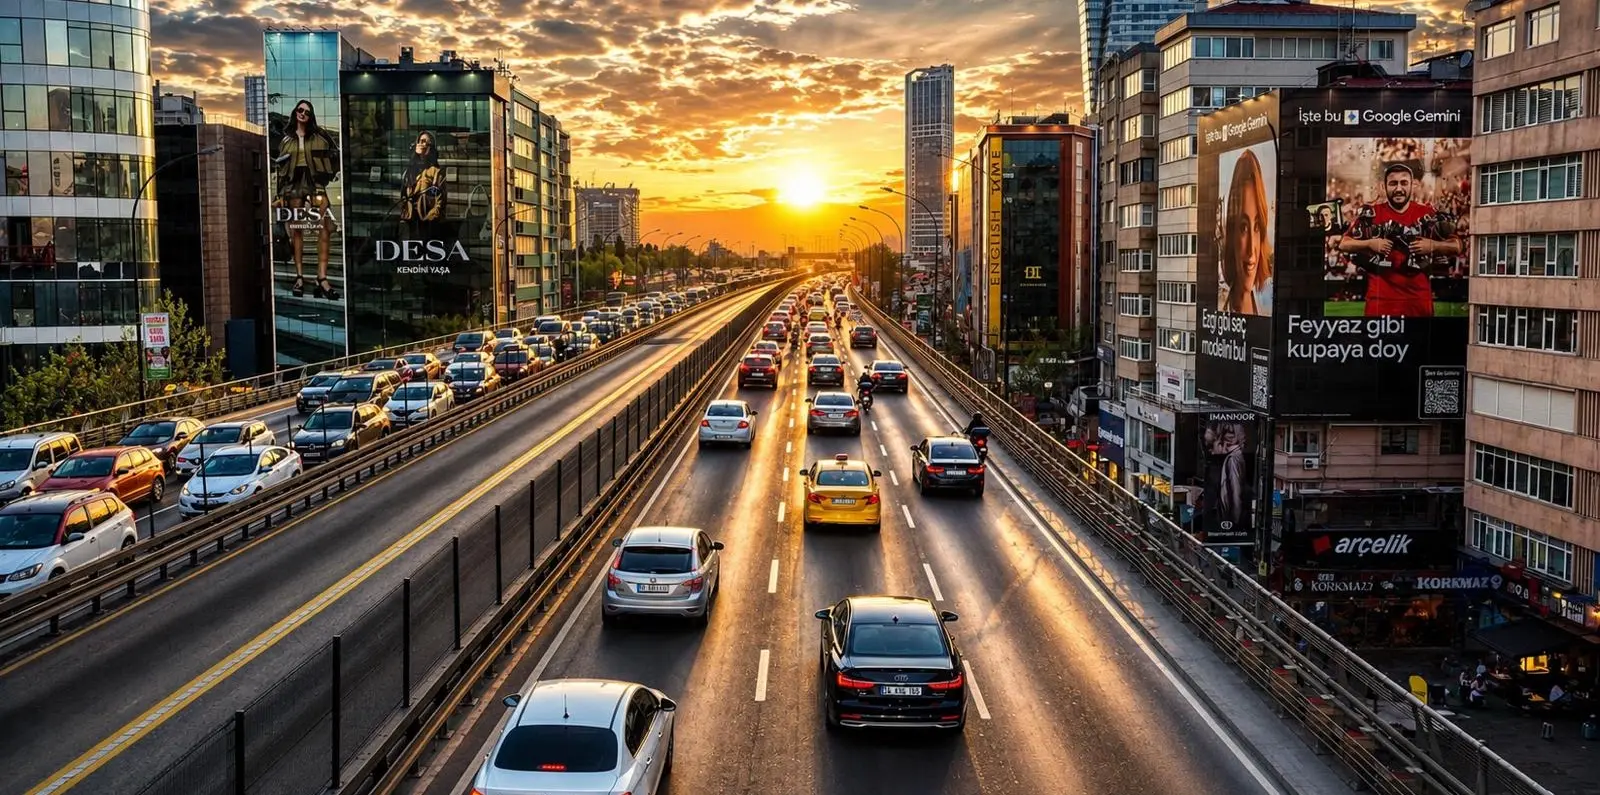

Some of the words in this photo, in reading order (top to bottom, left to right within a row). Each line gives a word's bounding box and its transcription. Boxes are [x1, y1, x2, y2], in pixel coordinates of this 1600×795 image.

[1298, 107, 1321, 125] İşte
[1324, 109, 1341, 122] bu
[1363, 109, 1411, 126] Google
[1414, 109, 1461, 122] Gemini
[276, 207, 337, 222] DESA
[375, 239, 470, 261] DESA
[430, 266, 451, 276] YAŞA
[1202, 308, 1218, 335] Ezgi
[1231, 317, 1247, 340] saç
[1288, 314, 1362, 339] Feyyaz
[1366, 314, 1405, 339] gibi
[1233, 339, 1246, 362] bul
[1287, 339, 1364, 363] kupaya
[1368, 339, 1410, 363] doy
[1334, 534, 1413, 557] arçelik
[1416, 576, 1490, 590] KORKMAZ
